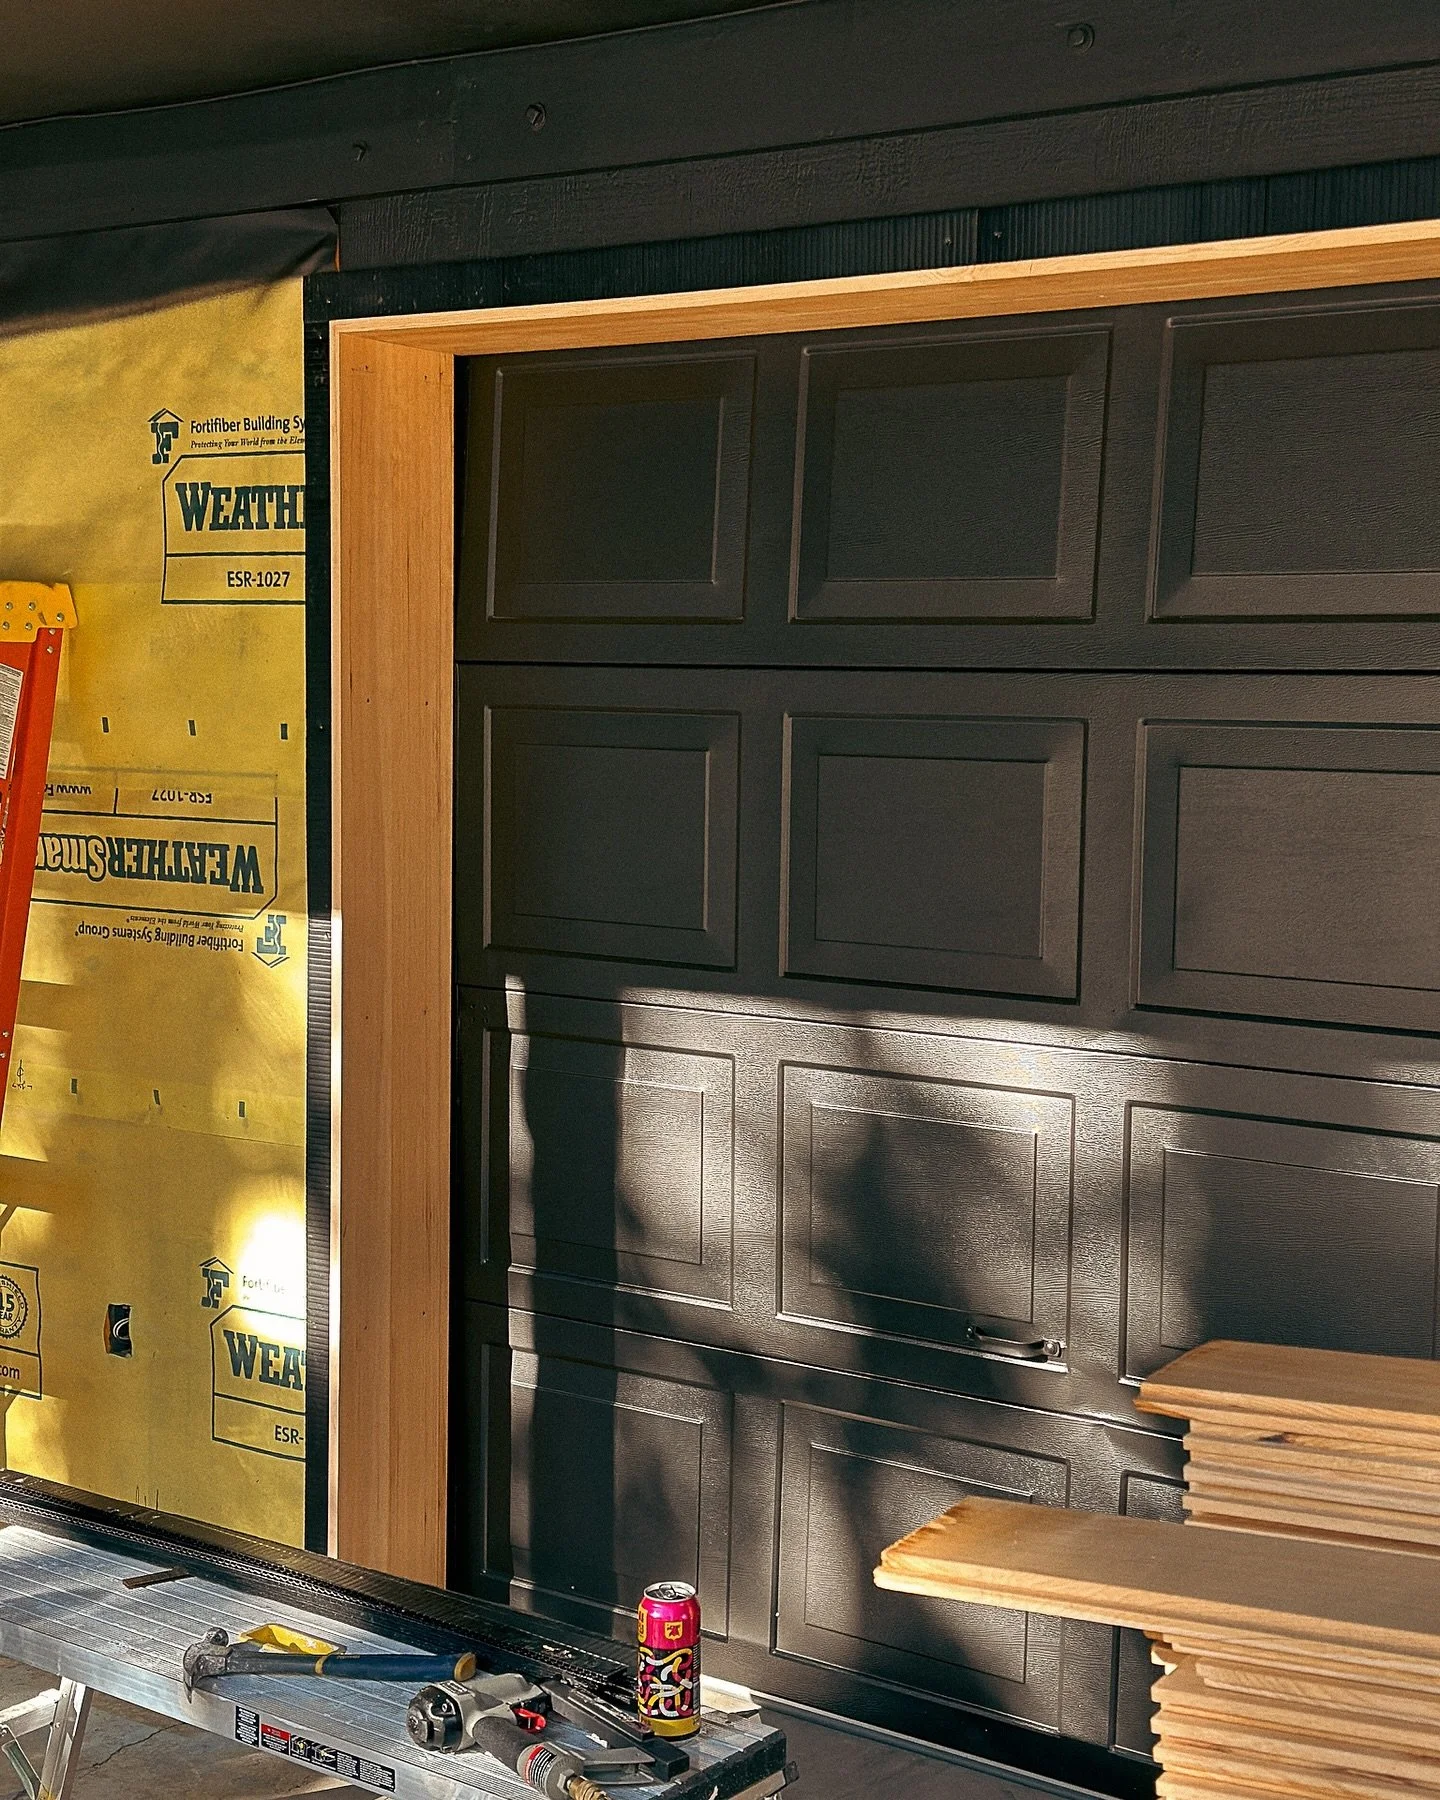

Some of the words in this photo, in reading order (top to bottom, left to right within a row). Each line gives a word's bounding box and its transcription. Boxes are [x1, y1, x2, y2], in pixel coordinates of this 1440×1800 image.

[190, 417, 240, 434] Fortifiber
[244, 415, 290, 433] Building
[190, 440, 222, 449] Protecting
[224, 439, 239, 447] Your
[240, 437, 259, 446] World
[259, 438, 275, 448] from
[277, 437, 287, 445] the
[175, 482, 305, 531] WEATH
[227, 571, 290, 587] ESR-1027
[157, 918, 167, 926] the
[168, 917, 183, 928] from
[183, 919, 200, 929] World
[201, 921, 214, 929] Your
[113, 926, 152, 943] Systems
[155, 928, 195, 948] Building
[197, 935, 244, 952] Fortifiber
[223, 1329, 306, 1391] WEA
[275, 1425, 305, 1445] ESR-
